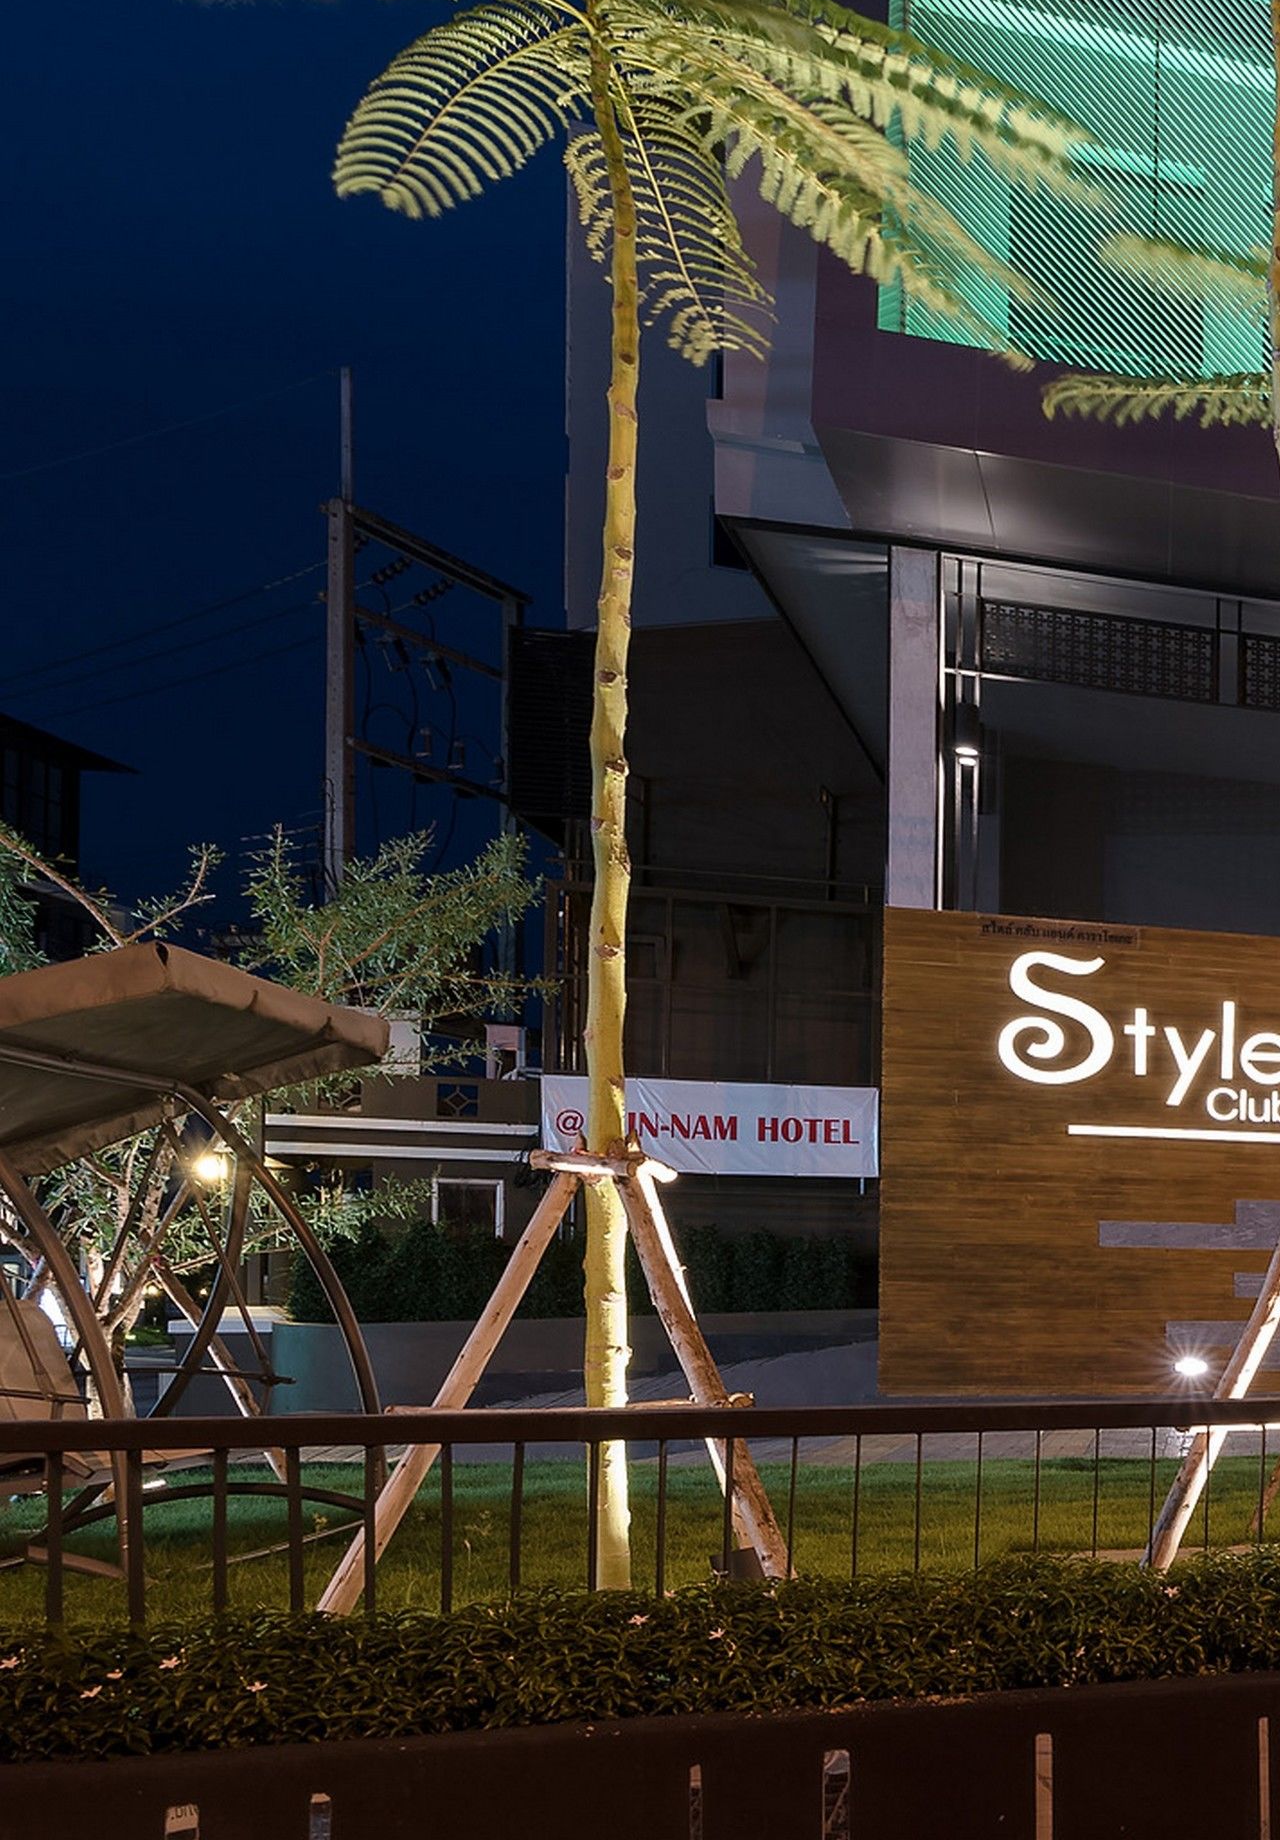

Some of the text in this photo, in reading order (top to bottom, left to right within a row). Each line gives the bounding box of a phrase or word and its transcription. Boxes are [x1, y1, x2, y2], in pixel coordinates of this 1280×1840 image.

[556, 1109, 860, 1145] @ IN-NAM HOTEL
